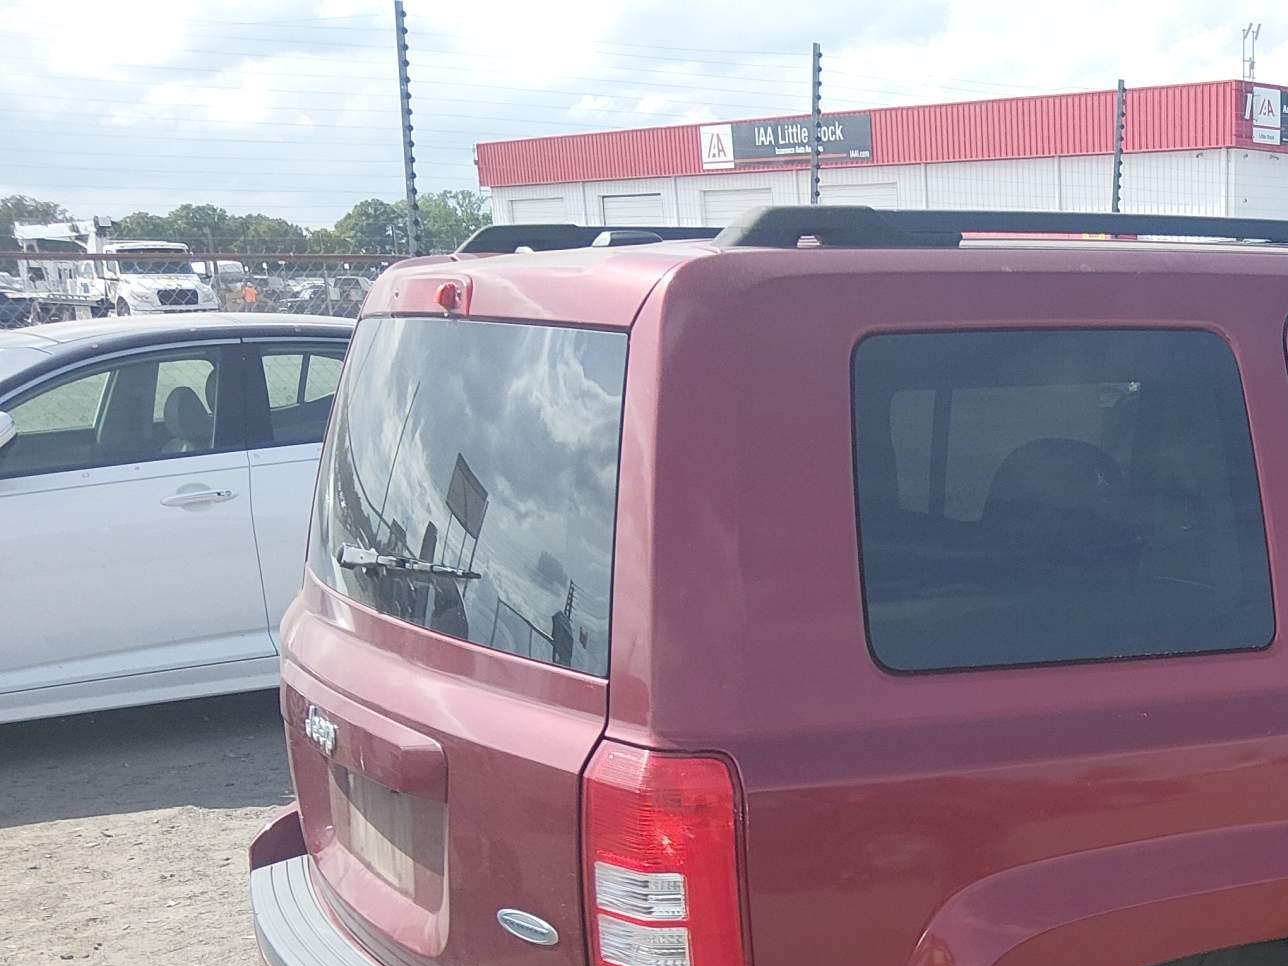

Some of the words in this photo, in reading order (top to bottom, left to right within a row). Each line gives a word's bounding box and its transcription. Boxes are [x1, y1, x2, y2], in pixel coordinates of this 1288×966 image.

[754, 127, 775, 146] IAA
[778, 123, 809, 145] Little
[813, 121, 844, 143] ock
